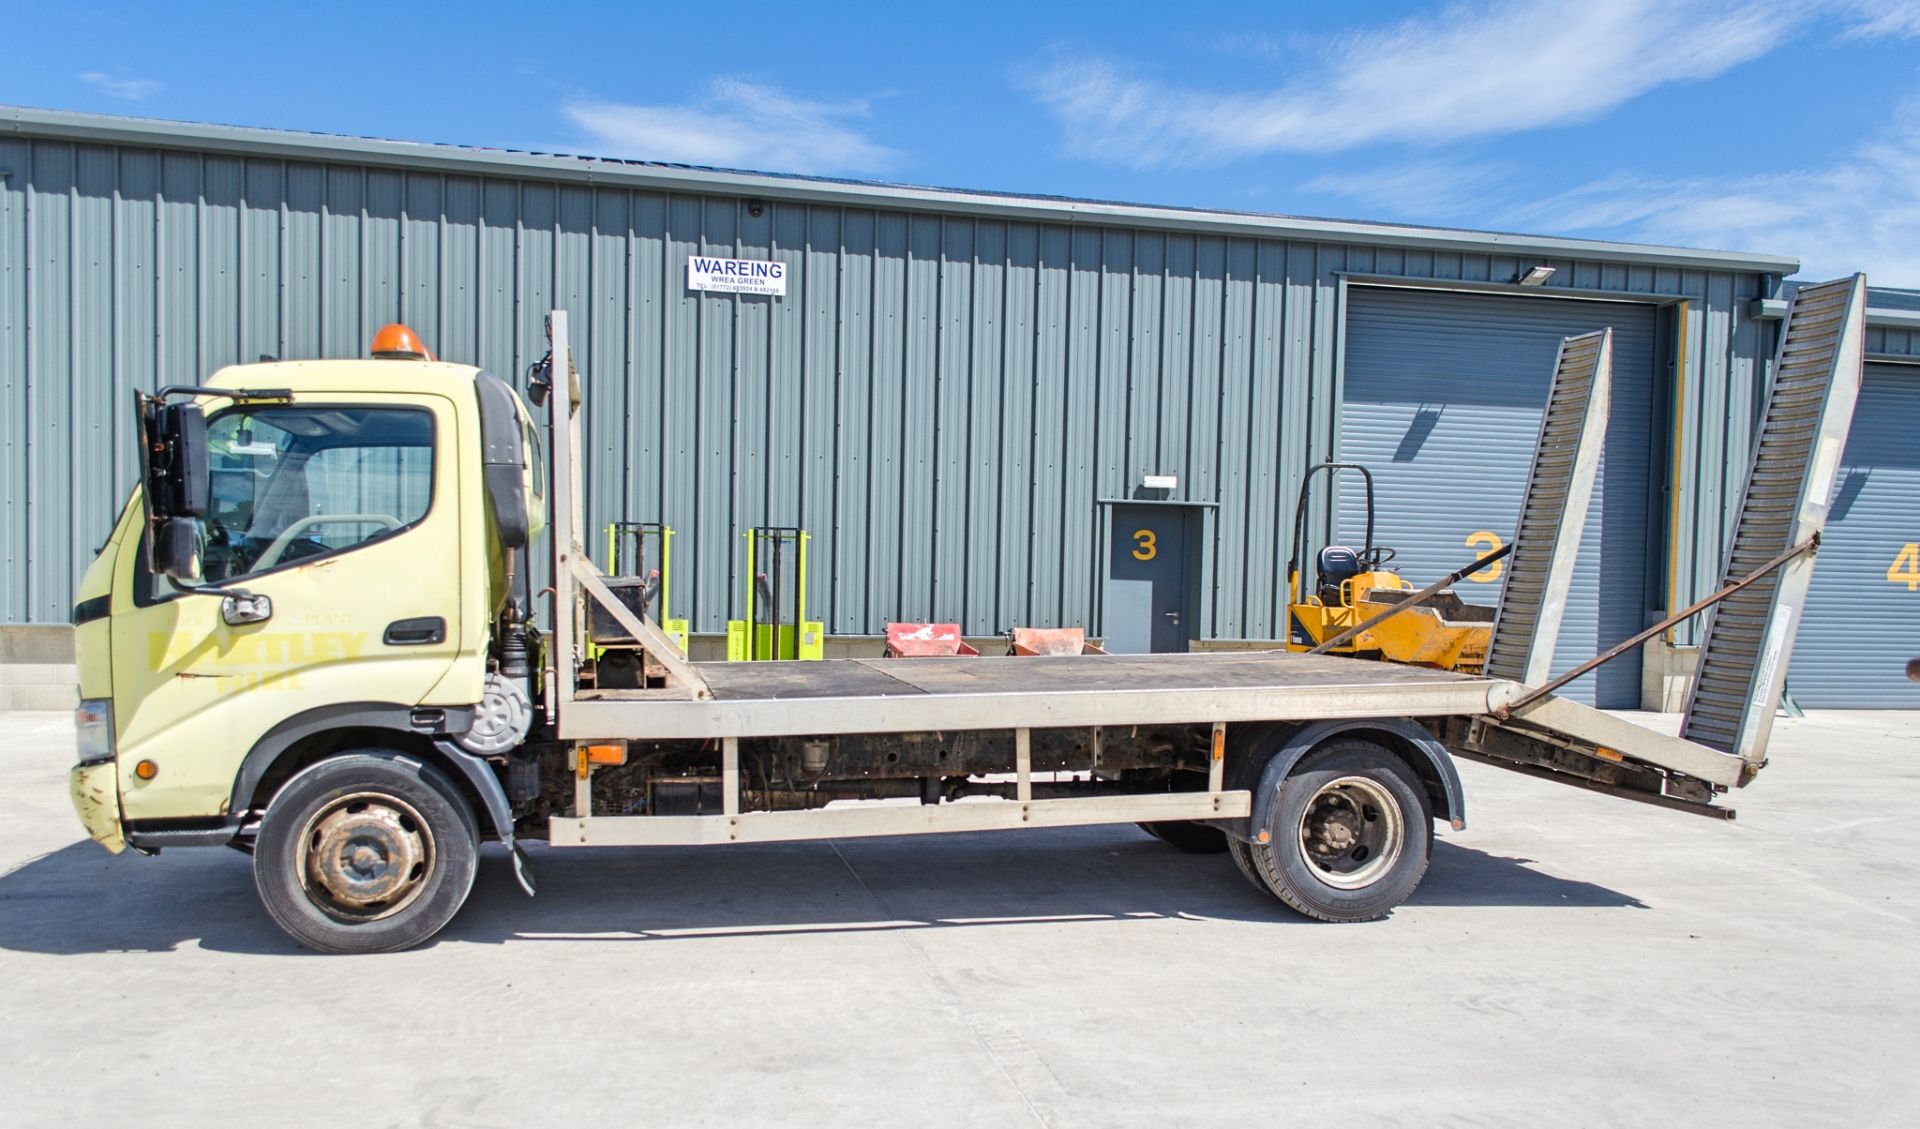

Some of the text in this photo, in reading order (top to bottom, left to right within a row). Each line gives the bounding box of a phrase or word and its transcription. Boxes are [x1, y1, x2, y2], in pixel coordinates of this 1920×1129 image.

[694, 258, 782, 279] WAREING
[711, 276, 765, 285] WREA GREEN
[1132, 529, 1157, 561] 3
[1465, 531, 1503, 583] 3
[1887, 543, 1920, 592] 4
[304, 612, 353, 625] PLANT
